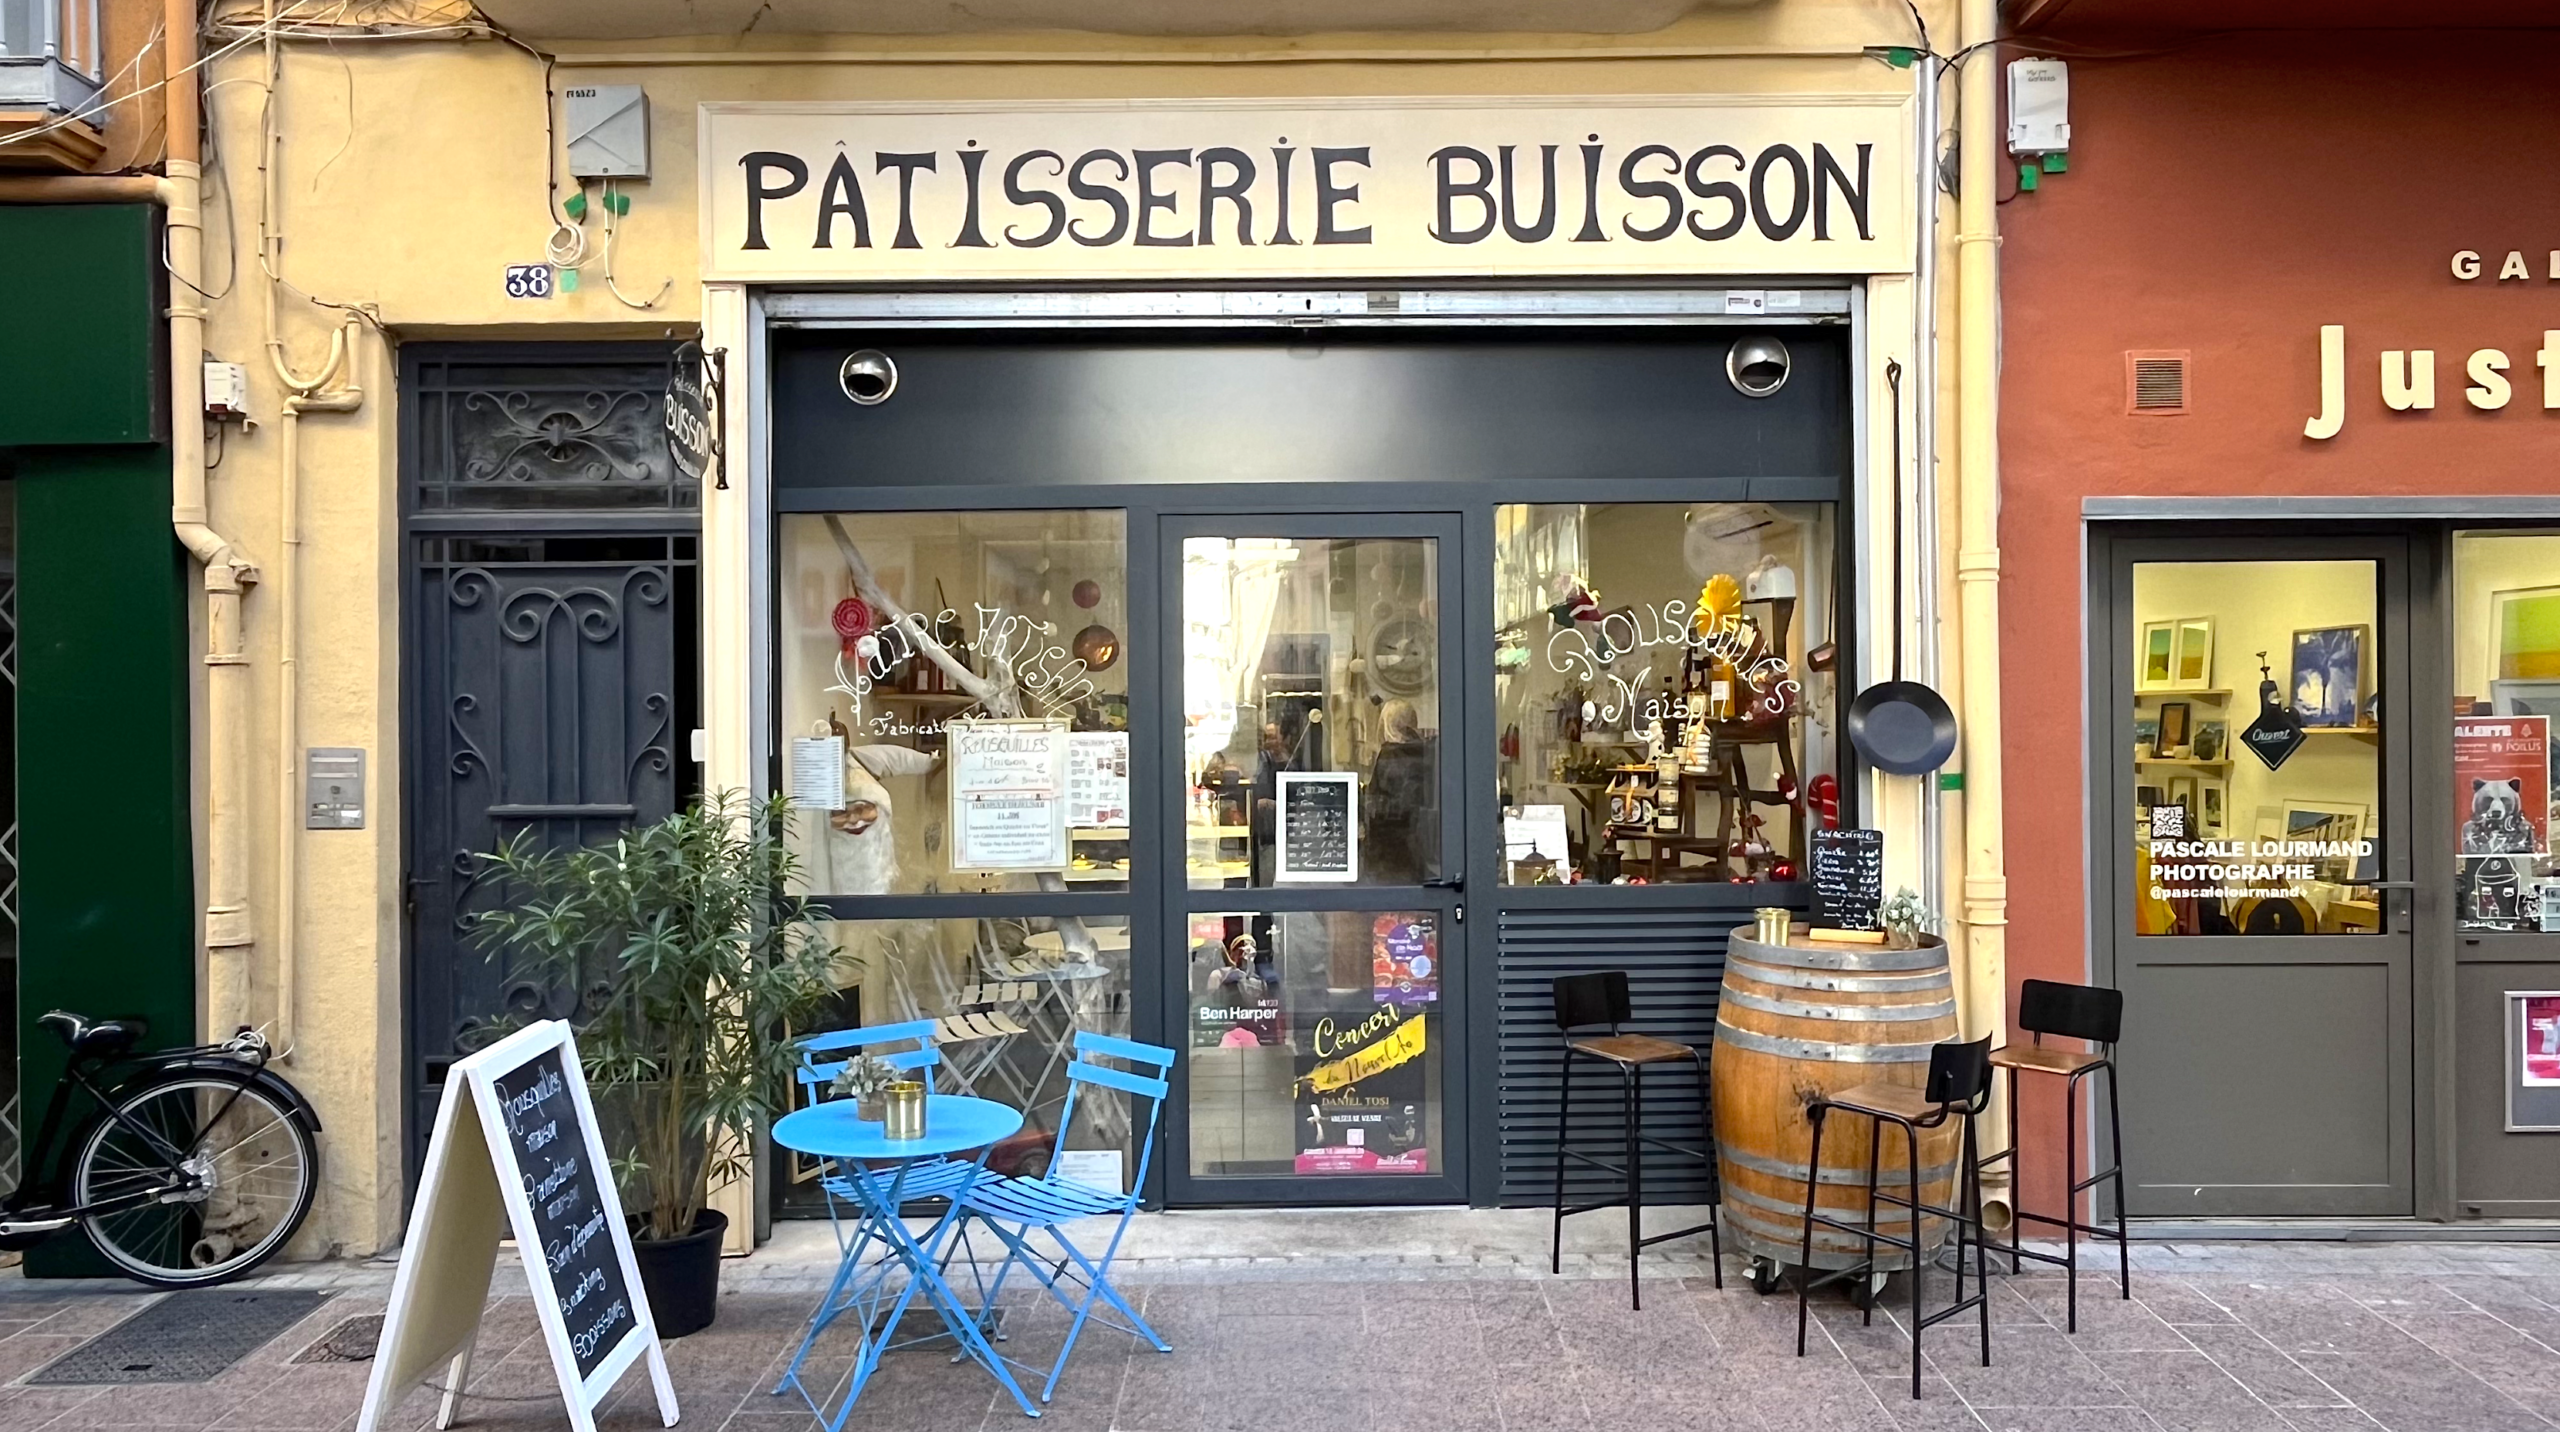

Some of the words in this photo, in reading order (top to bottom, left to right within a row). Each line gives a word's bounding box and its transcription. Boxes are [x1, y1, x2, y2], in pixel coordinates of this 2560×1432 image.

[738, 137, 1373, 250] PÂTISSERIE
[1426, 132, 1876, 244] BUISSON
[508, 266, 549, 296] 38
[665, 393, 710, 457] BUISSON
[2150, 841, 2245, 858] PASCALE
[2251, 841, 2373, 858] LOURMAND
[2150, 864, 2315, 881] PHOTOGRAPHE
[1200, 1006, 1228, 1020] Ben
[1229, 1006, 1278, 1022] Harper
[1314, 1002, 1400, 1058] Concert
